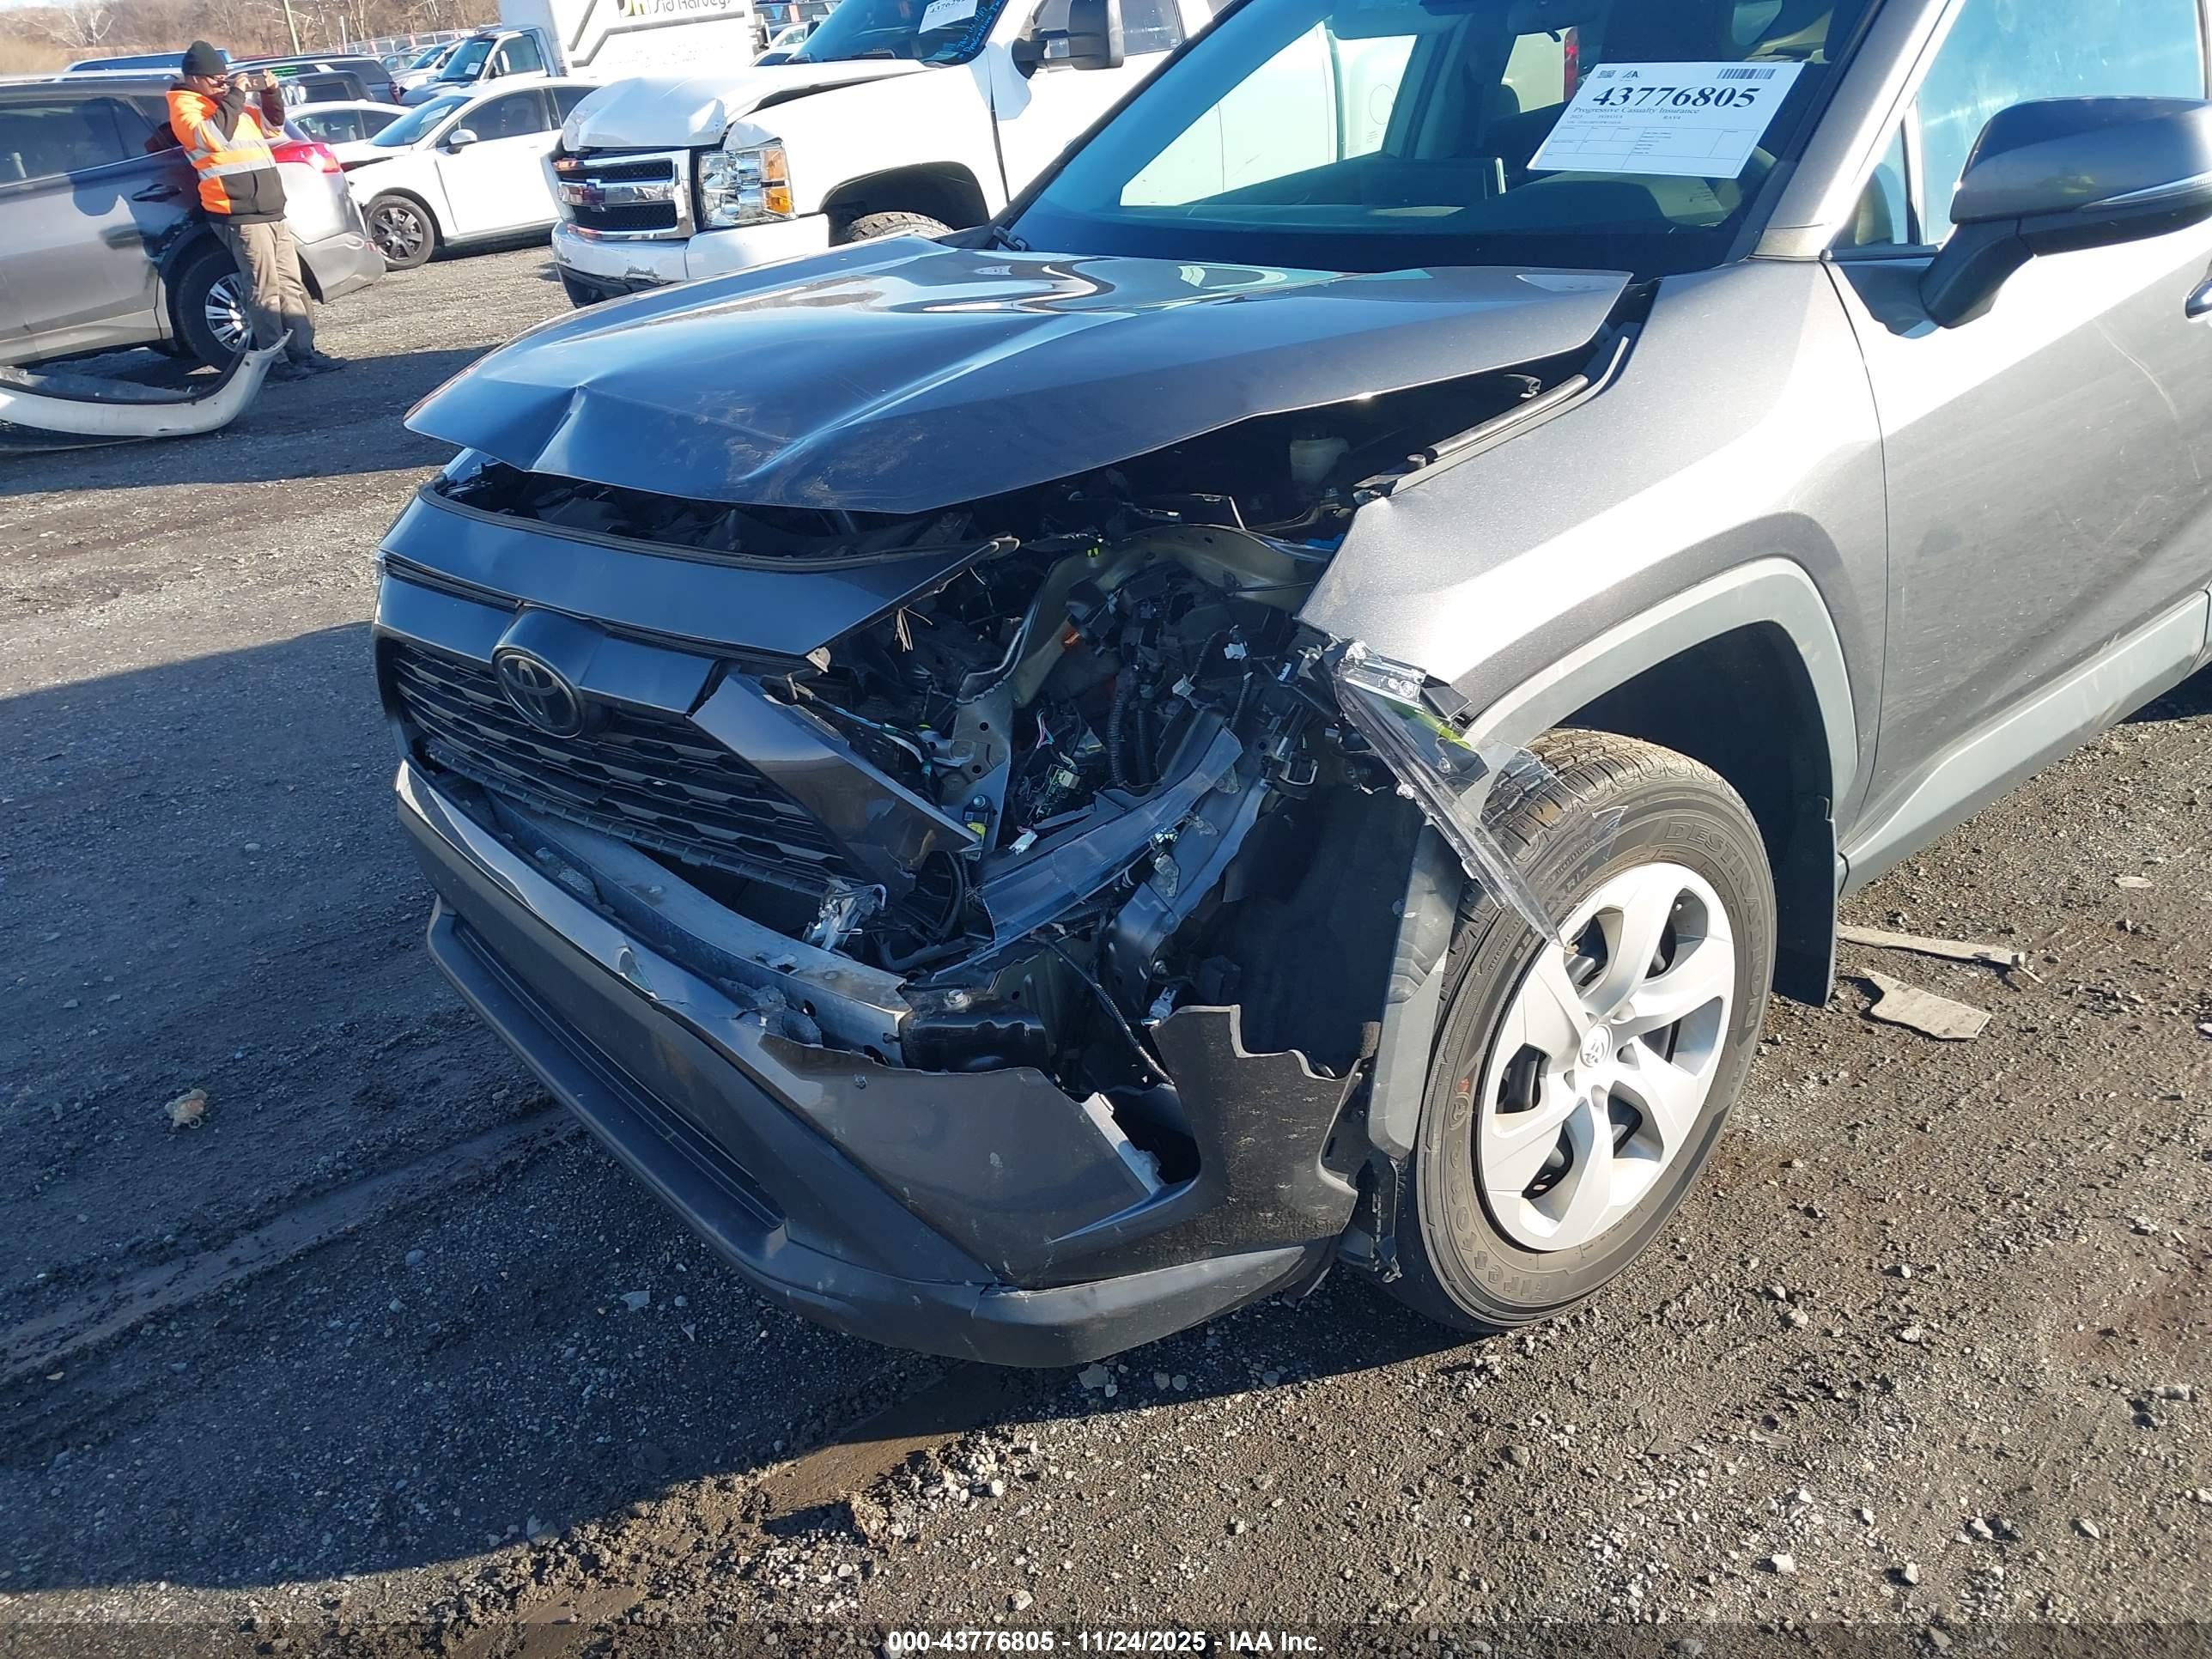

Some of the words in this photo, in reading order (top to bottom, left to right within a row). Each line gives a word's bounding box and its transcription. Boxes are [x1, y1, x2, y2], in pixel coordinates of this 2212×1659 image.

[1592, 87, 1760, 108] 43776805
[1573, 106, 1620, 115] Progressive
[1664, 822, 1765, 1029] DESTINATION
